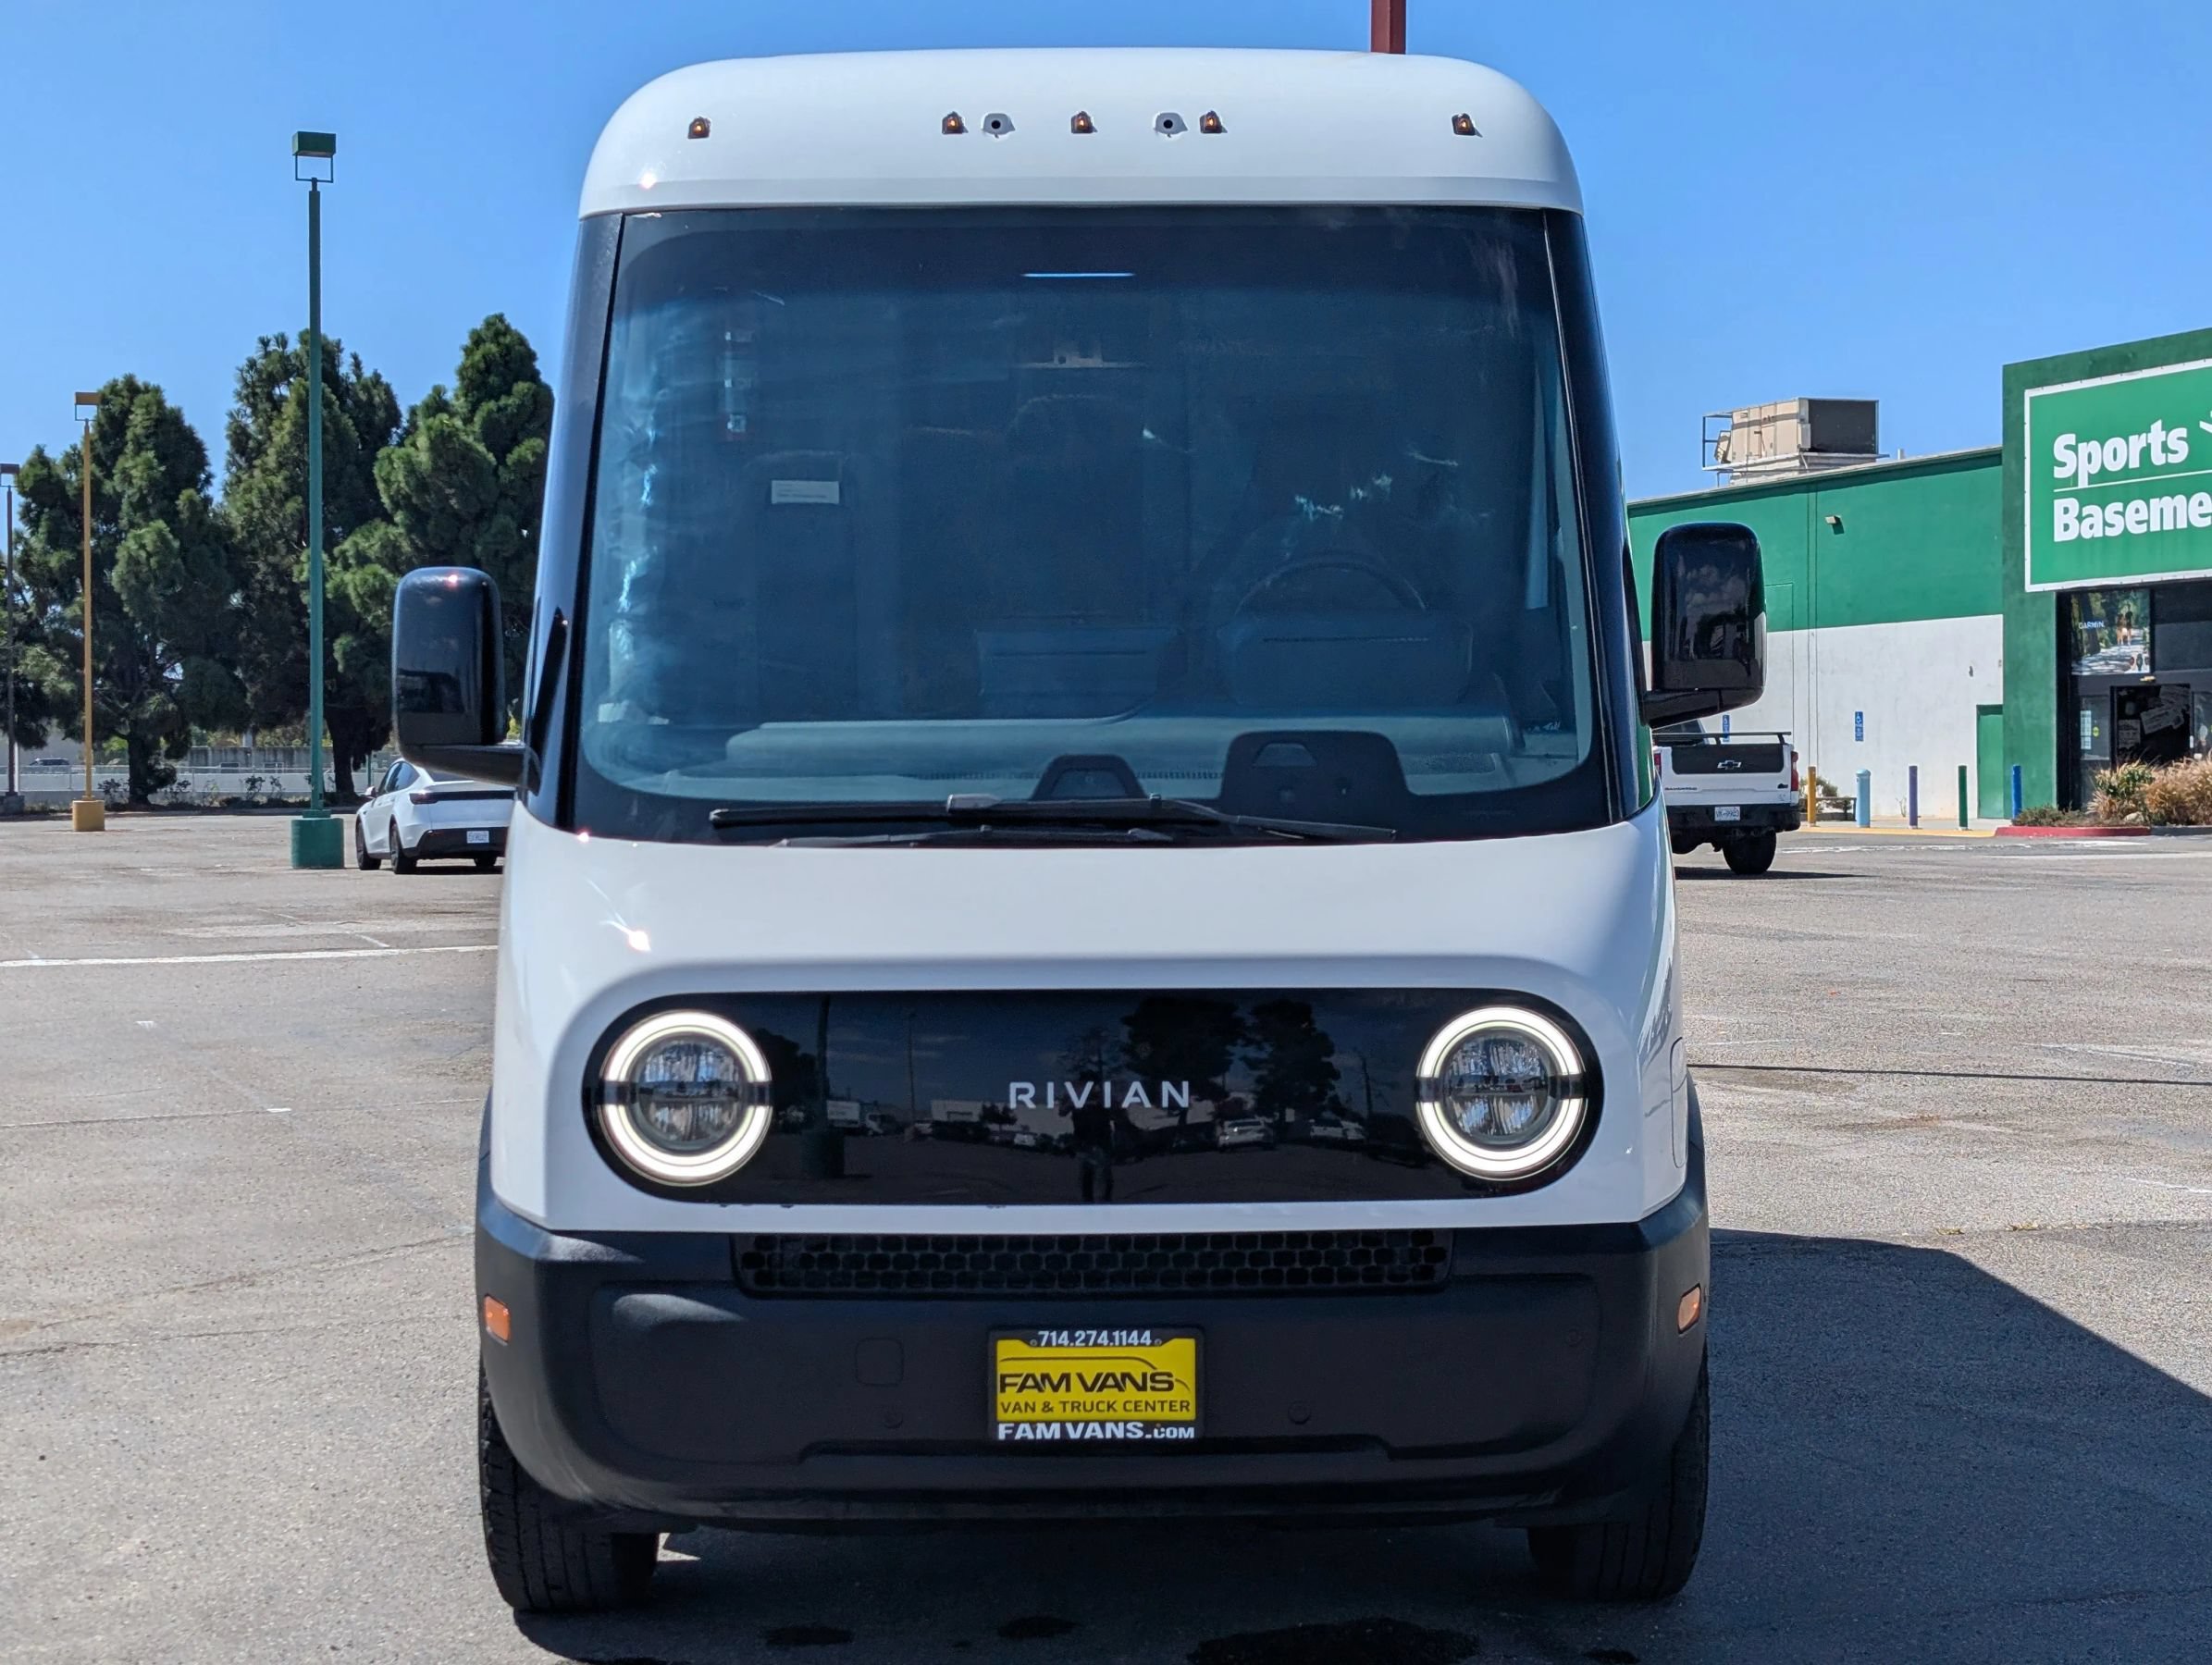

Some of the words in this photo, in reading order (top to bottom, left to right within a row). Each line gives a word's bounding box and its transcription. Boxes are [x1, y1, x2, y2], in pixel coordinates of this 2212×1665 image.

[2053, 419, 2189, 487] Sports
[1009, 1080, 1190, 1109] RIVIAN
[1038, 1330, 1152, 1347] 714.274.1144
[1000, 1400, 1036, 1413] VAN
[1042, 1401, 1054, 1412] &
[1059, 1400, 1117, 1412] TRUCK
[1122, 1400, 1191, 1412] CENTER
